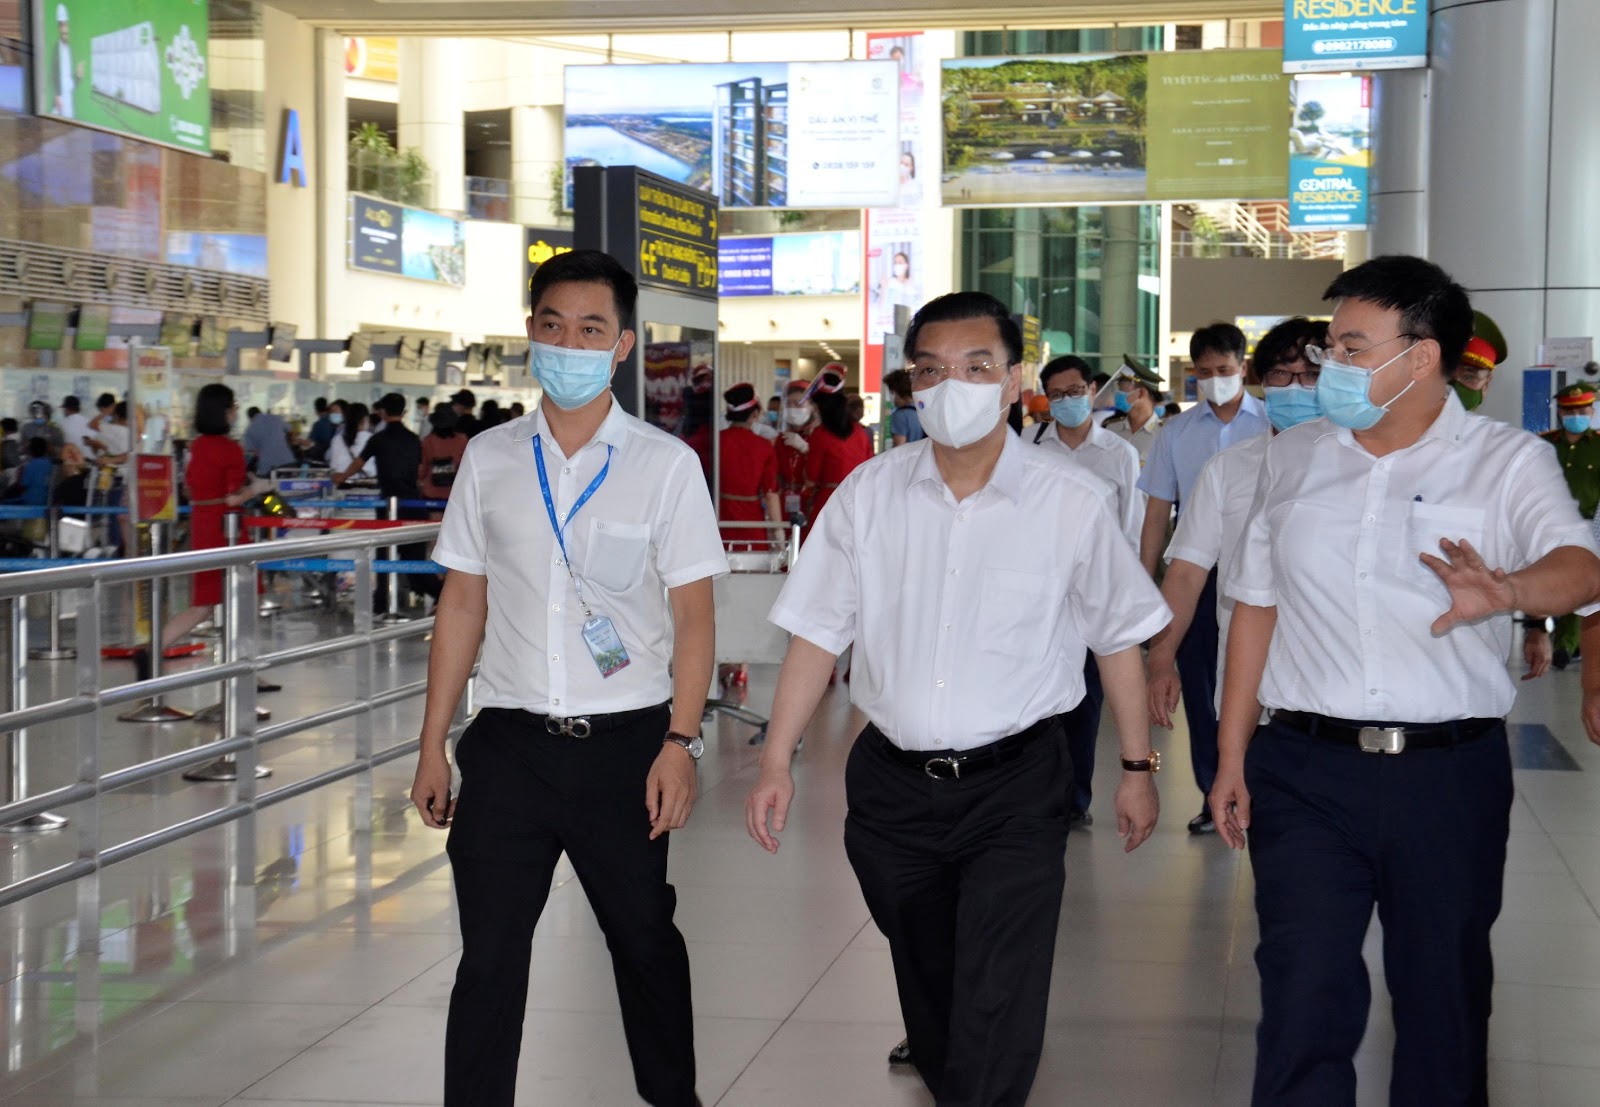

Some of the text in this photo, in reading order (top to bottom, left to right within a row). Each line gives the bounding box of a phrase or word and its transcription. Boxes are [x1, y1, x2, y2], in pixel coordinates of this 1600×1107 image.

[1293, 0, 1418, 19] RESIDENCE
[281, 109, 306, 188] A
[1299, 178, 1357, 191] CENTRAL
[1293, 190, 1362, 203] RESIDENCE
